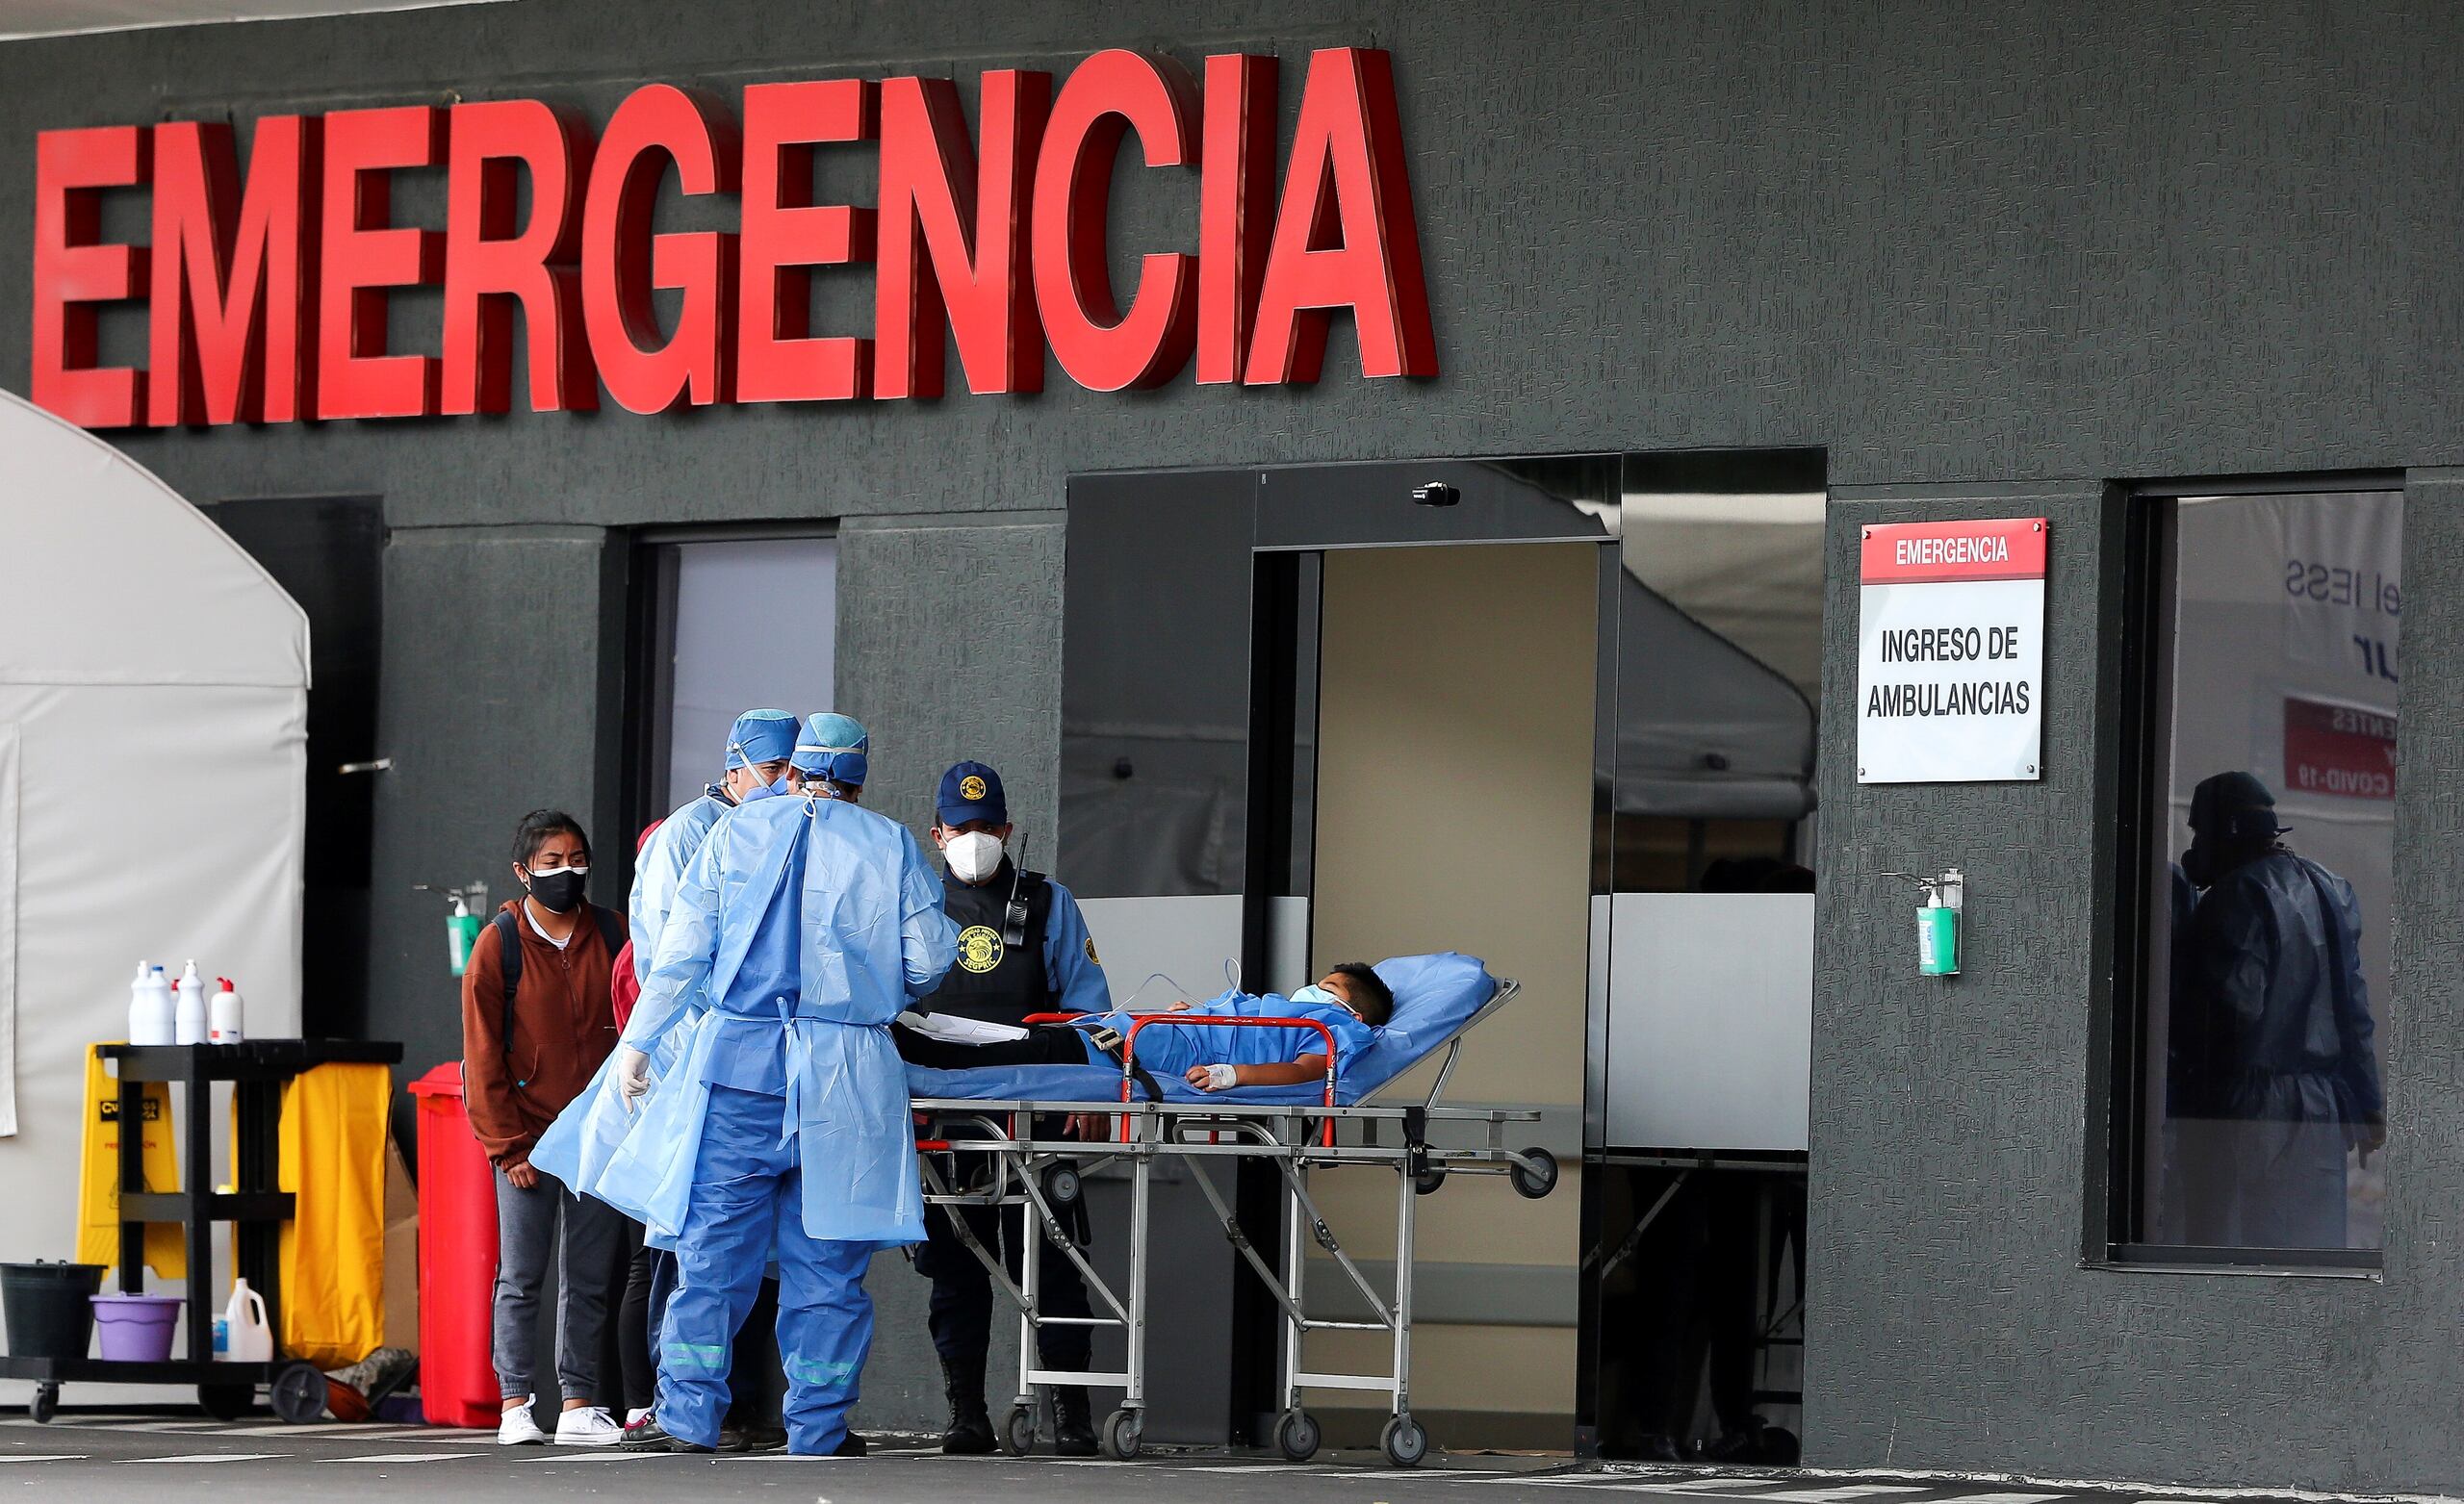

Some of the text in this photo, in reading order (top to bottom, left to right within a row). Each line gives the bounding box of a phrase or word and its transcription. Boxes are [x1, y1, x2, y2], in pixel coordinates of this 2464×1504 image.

[32, 46, 1439, 428] EMERGENCIA
[1895, 536, 2010, 565] EMERGENCIA
[1882, 626, 2018, 662] INGRESO DE
[1867, 680, 2030, 718] AMBULANCIAS
[963, 956, 996, 970] SEGPRIC
